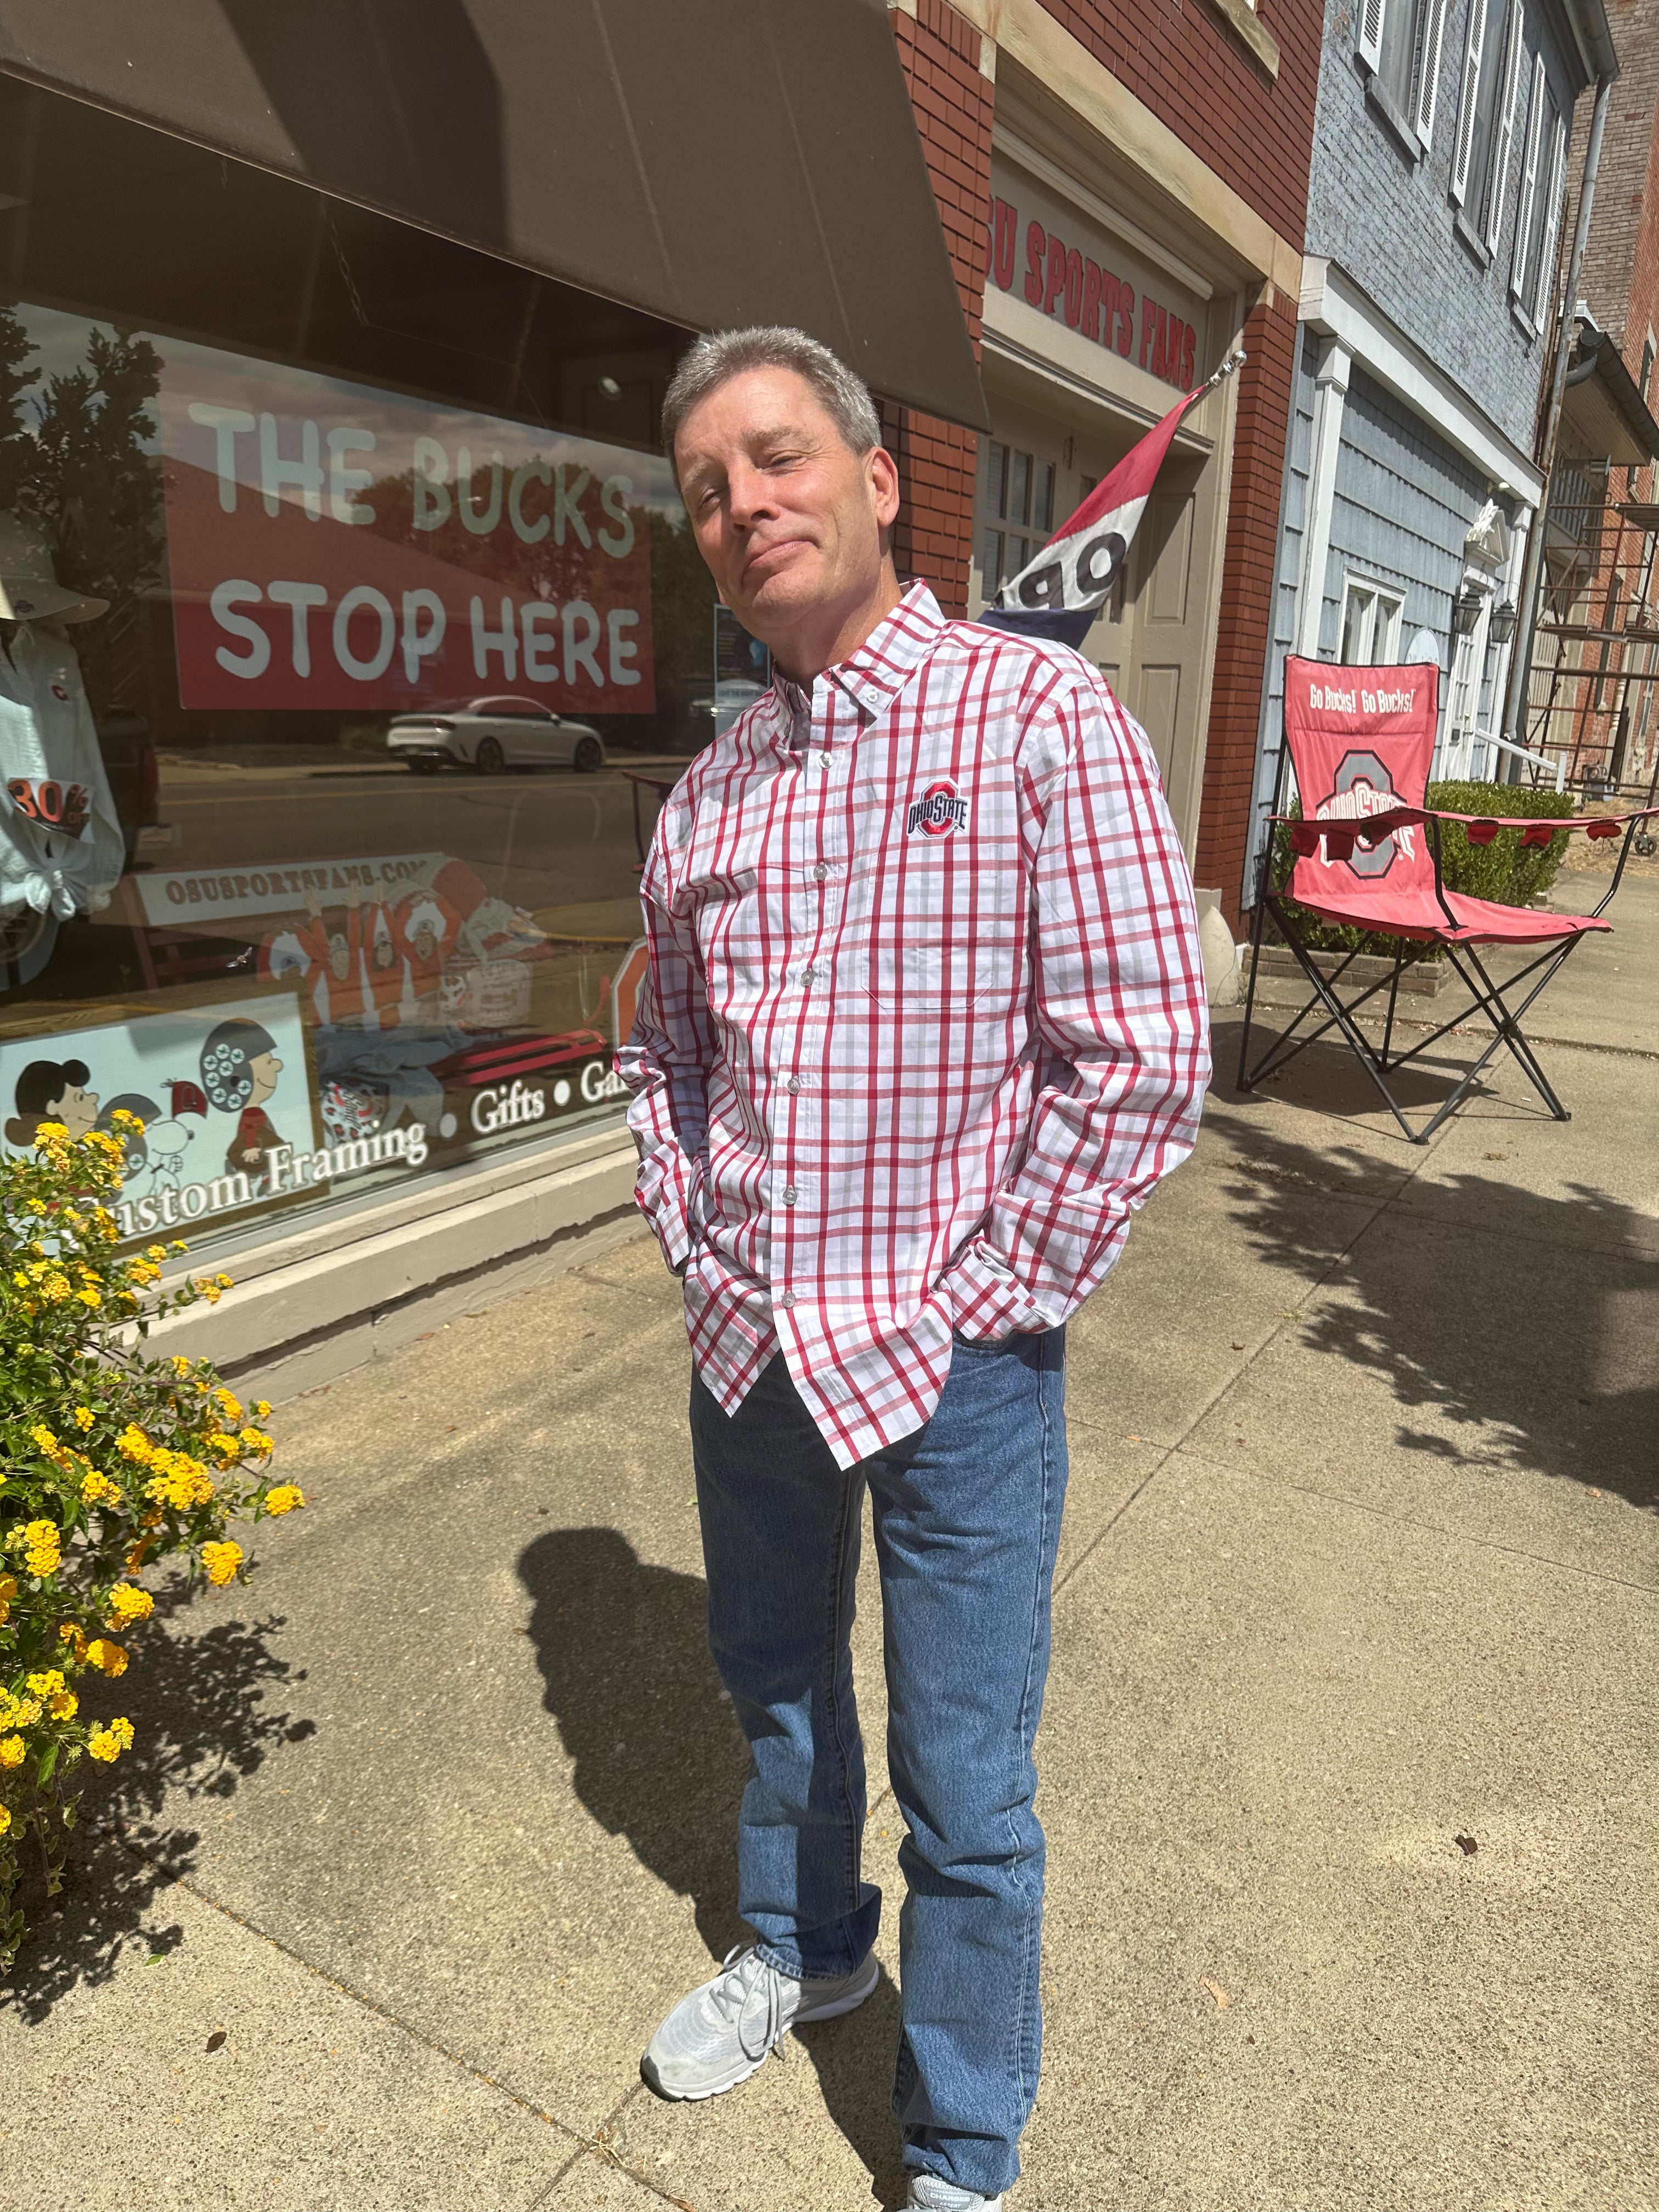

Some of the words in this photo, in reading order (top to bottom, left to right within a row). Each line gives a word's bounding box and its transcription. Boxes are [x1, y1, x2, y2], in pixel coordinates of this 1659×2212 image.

[1024, 221, 1135, 358] SPORTS
[1139, 295, 1196, 392] FANS
[188, 402, 376, 526] THE
[412, 437, 635, 558] BUCKS
[210, 579, 446, 684] STOP
[470, 595, 641, 687] HERE
[1310, 683, 1323, 709] Go
[1324, 685, 1357, 713] Bucks!
[1361, 689, 1376, 713] Go
[1376, 688, 1413, 713] Bucks!
[908, 799, 934, 834] OHIO
[933, 794, 968, 830] STATE
[264, 1122, 428, 1197] Framing
[470, 1078, 545, 1135] Gifts
